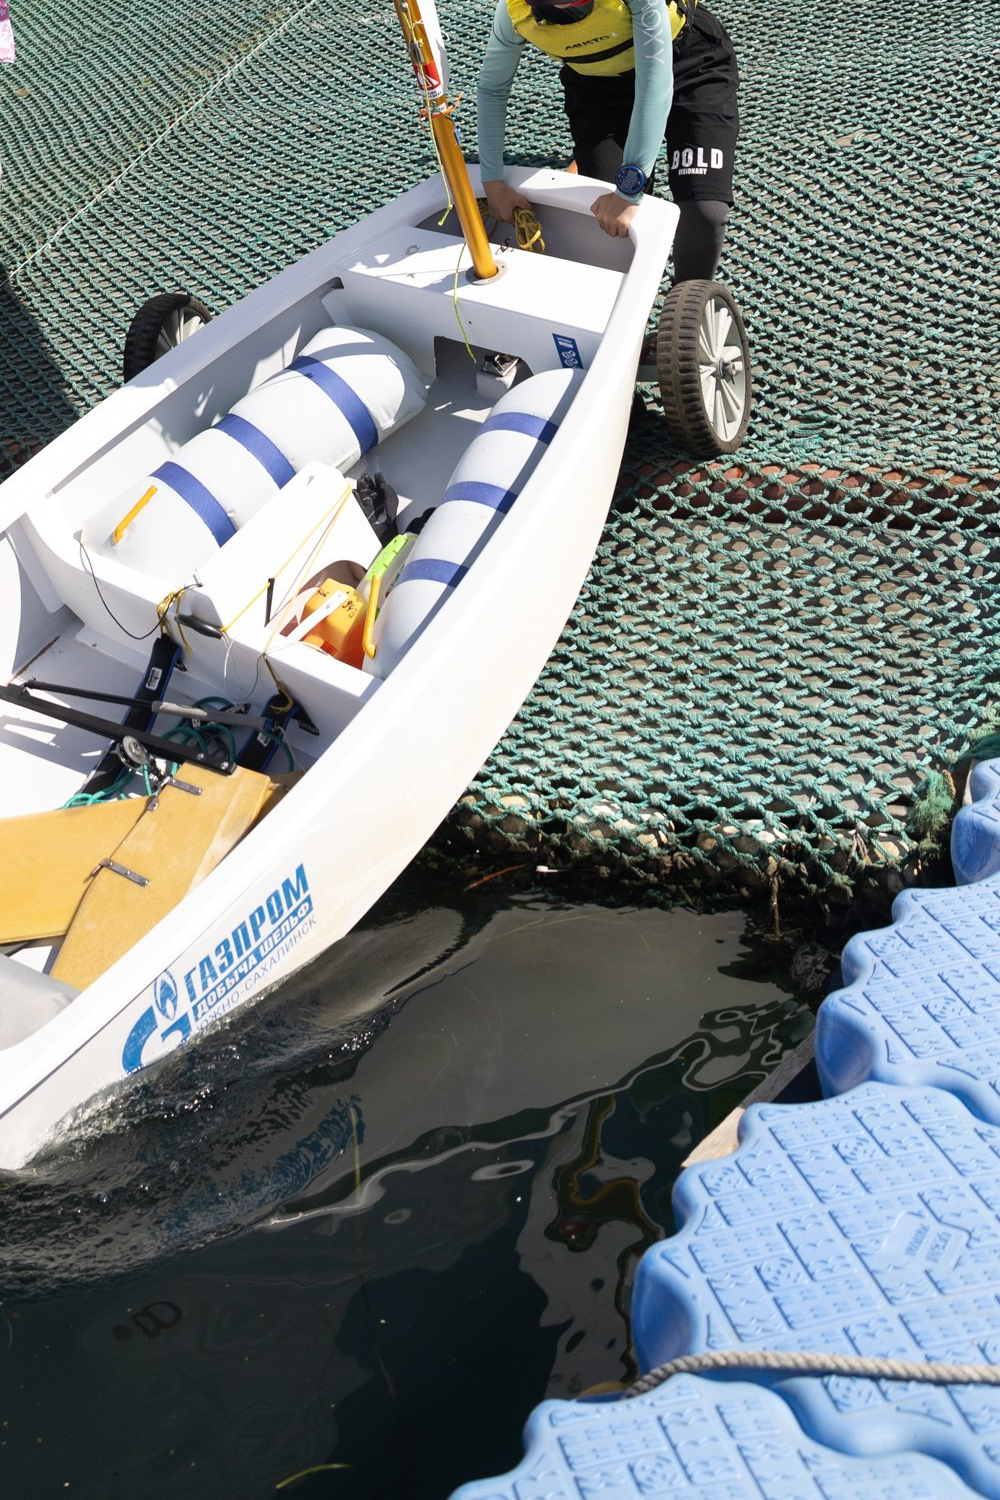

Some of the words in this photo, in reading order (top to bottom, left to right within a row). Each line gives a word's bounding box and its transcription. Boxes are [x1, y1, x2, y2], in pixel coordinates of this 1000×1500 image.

[565, 35, 610, 51] MUSTO
[671, 147, 724, 170] BOLD
[678, 167, 708, 176] VISIONARY
[184, 863, 310, 1003] ГАЗПРОМ
[196, 952, 257, 1017] ДОБЫЧА
[258, 901, 311, 957] ШЕЛЬФ
[197, 915, 318, 1032] ЮЖНО-САХАЛИНСК
